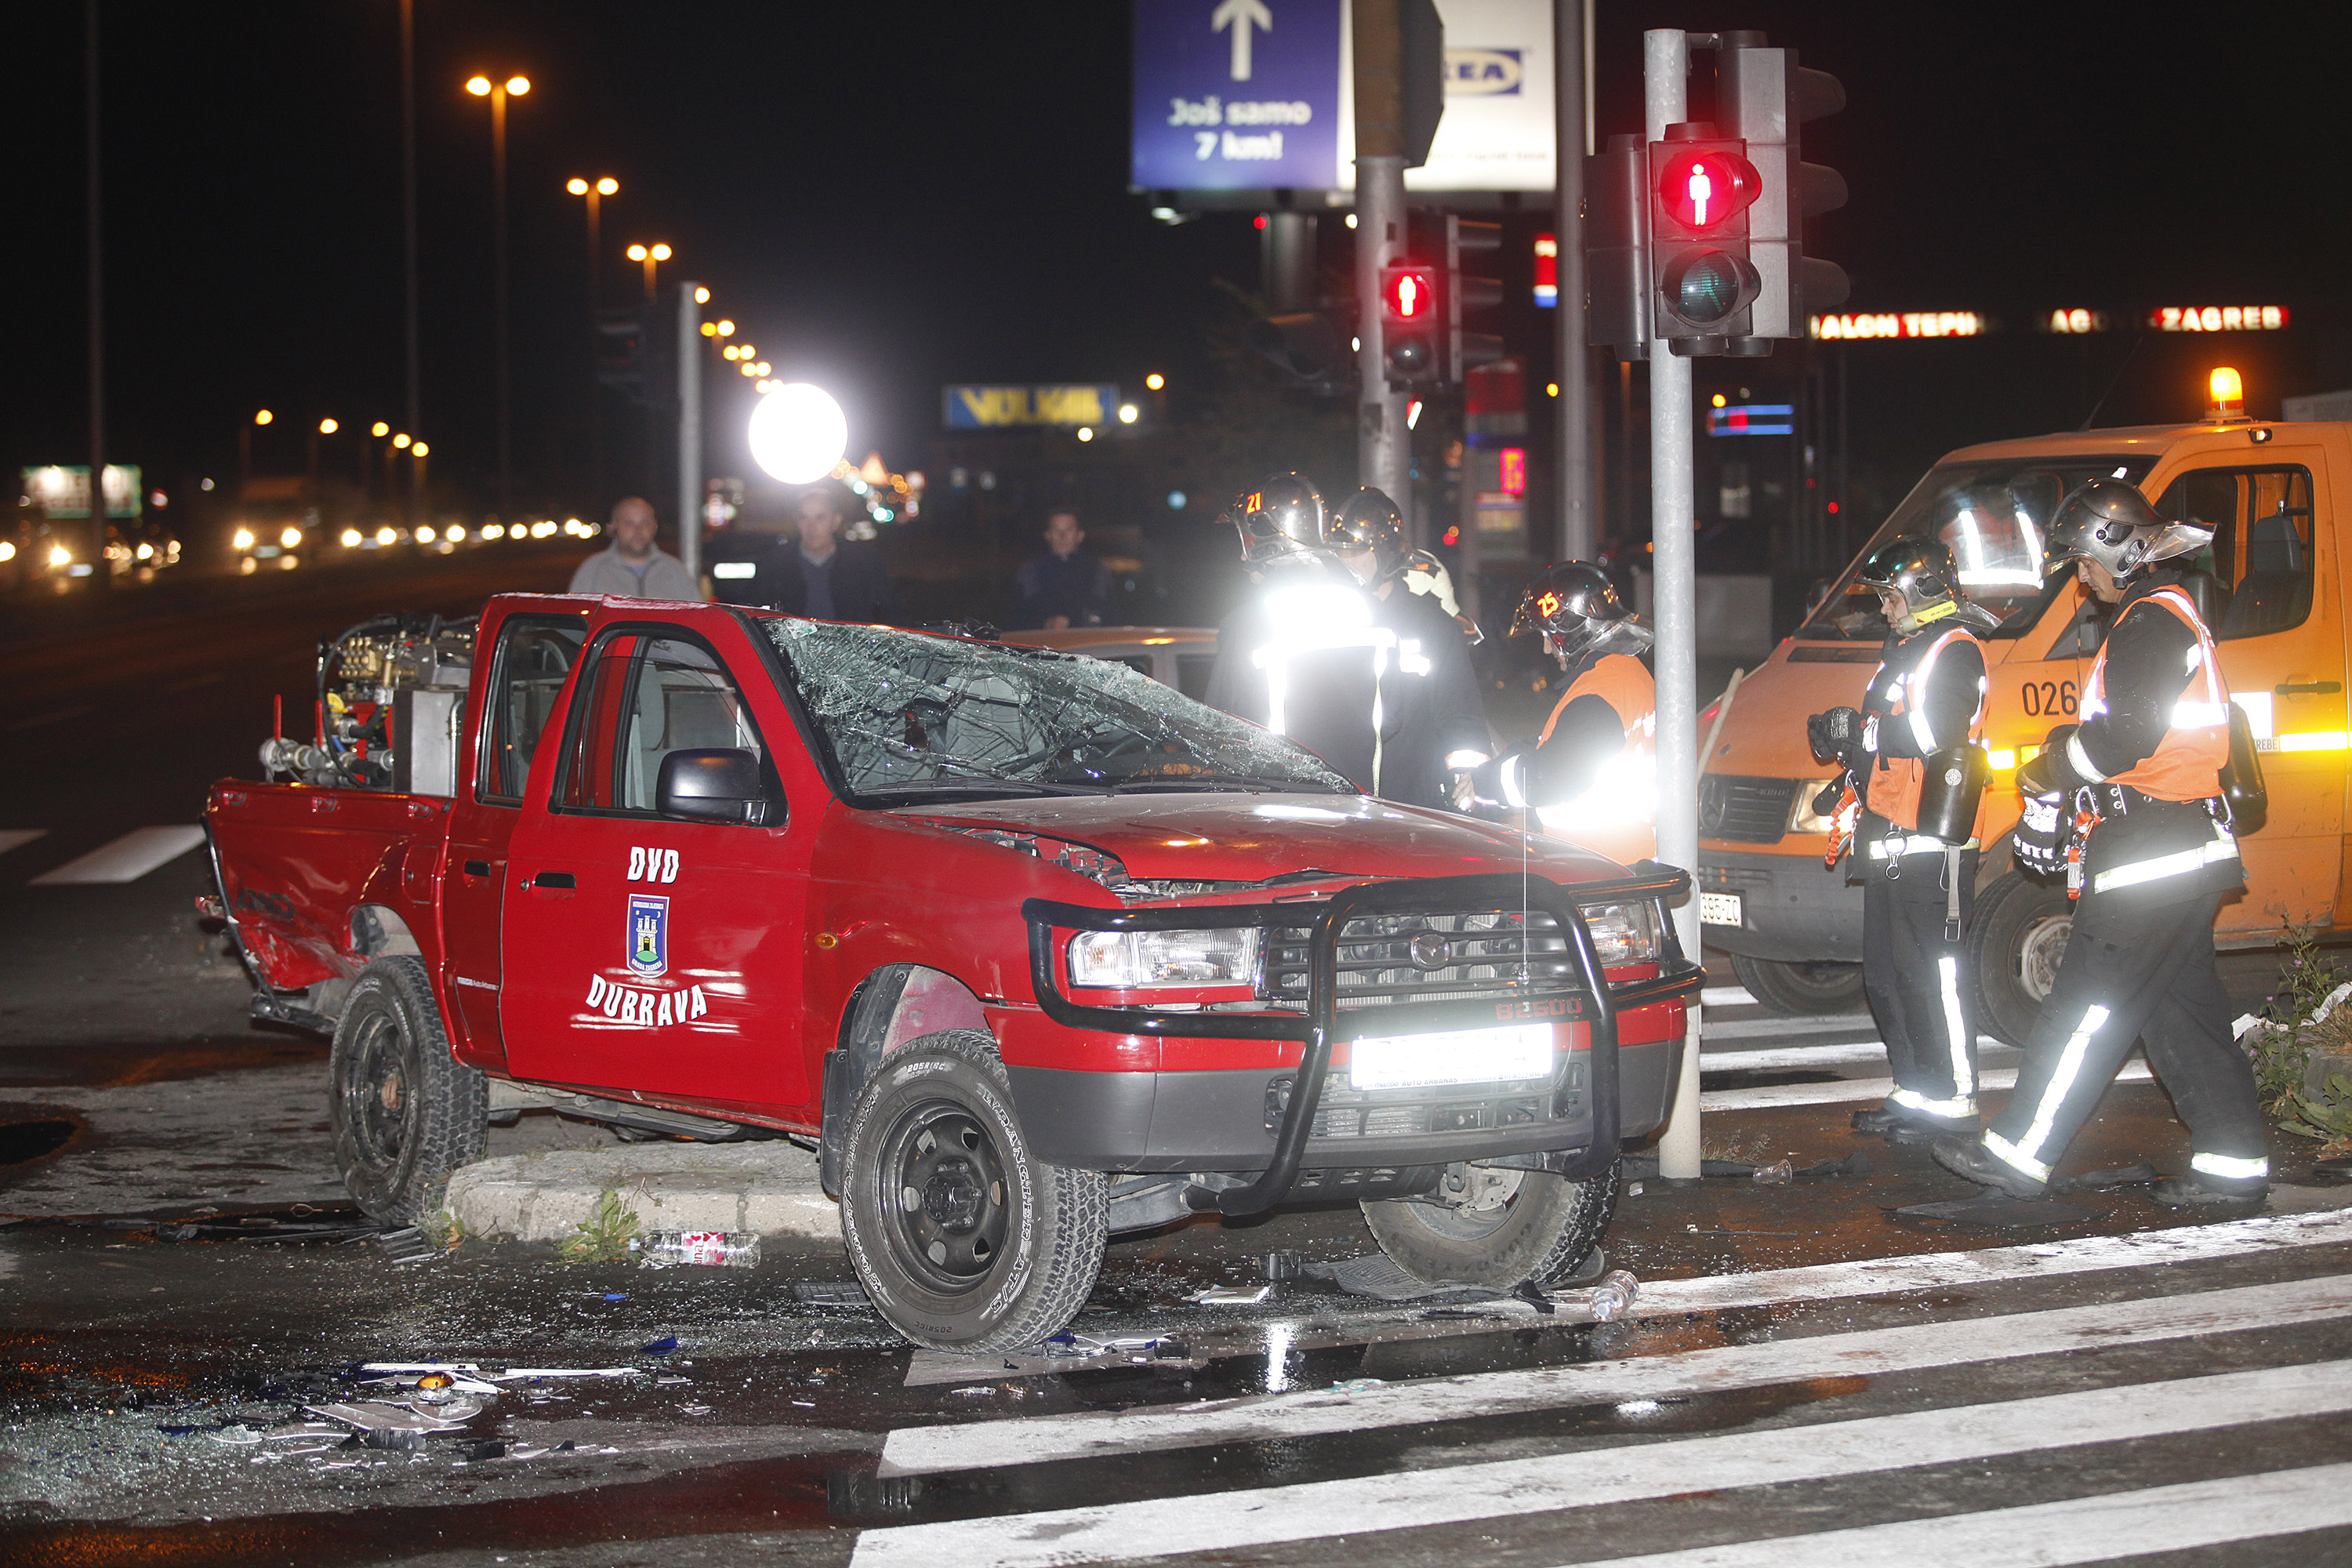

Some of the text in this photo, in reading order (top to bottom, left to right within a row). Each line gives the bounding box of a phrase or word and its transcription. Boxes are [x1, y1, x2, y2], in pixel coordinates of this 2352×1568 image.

[1194, 131, 1218, 160] 7
[2161, 306, 2282, 332] ZAGREB
[1246, 492, 1261, 514] 21
[1537, 591, 1559, 618] 25
[2022, 681, 2078, 717] 026
[627, 847, 680, 884] DVD
[586, 974, 707, 1026] DUBRAVA
[1495, 998, 1583, 1020] B2500
[982, 1088, 1033, 1242] WRANGLER
